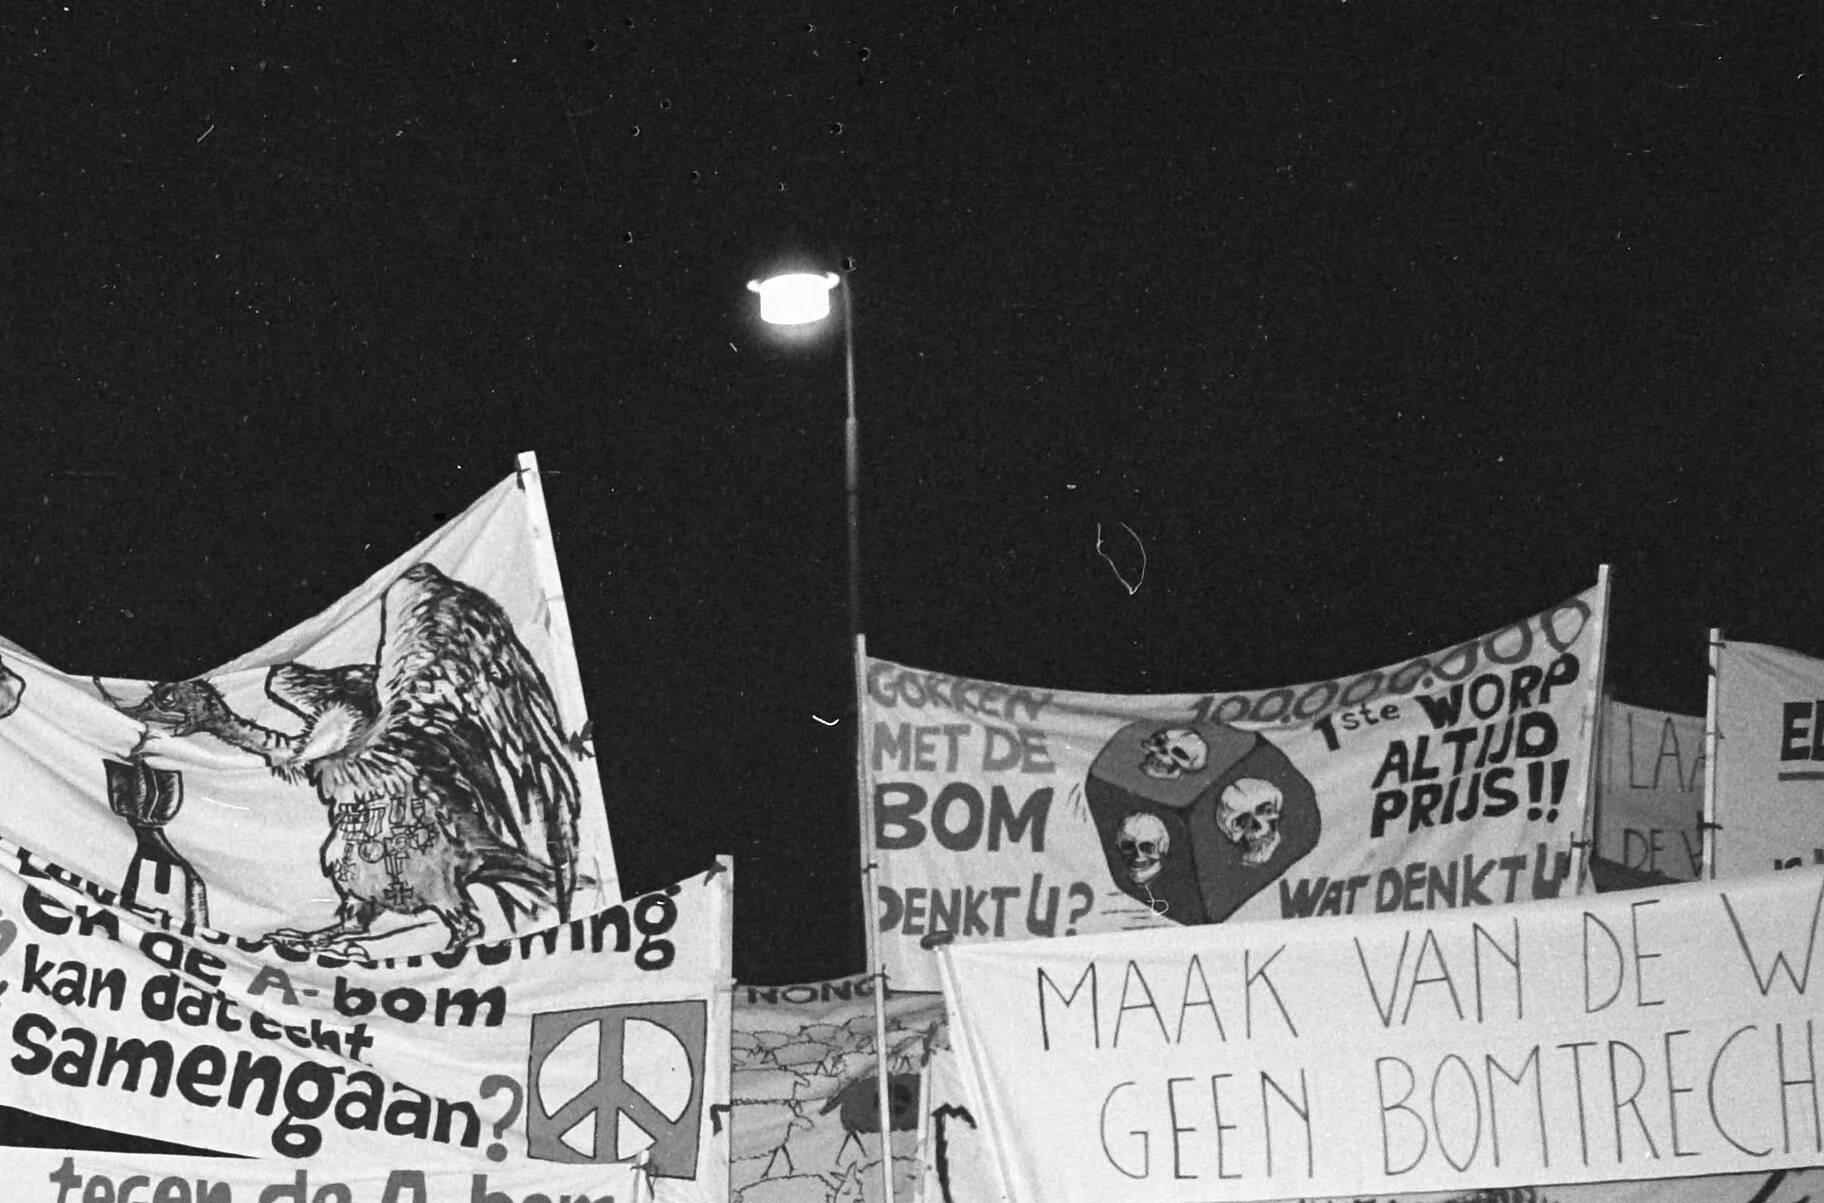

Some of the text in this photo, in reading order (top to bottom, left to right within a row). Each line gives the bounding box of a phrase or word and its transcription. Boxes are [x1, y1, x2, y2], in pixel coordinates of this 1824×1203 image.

[868, 664, 1054, 721] GOKKEN
[1313, 653, 1580, 751] 1ste WORP
[875, 721, 1056, 773] MET DE
[1371, 711, 1558, 787] ALTIJD
[876, 781, 1054, 852] BOM
[1370, 758, 1570, 838] PRIJS!!
[877, 873, 1095, 938] DENKT U?
[1279, 874, 1373, 920] WAT
[1375, 853, 1527, 914] DENKT
[21, 943, 127, 1012] kan
[140, 971, 243, 1034] dat
[246, 963, 507, 1028] A-bom
[1036, 944, 1299, 1052] MAAK
[1354, 916, 1524, 1029] VAN
[1582, 899, 1666, 1014] DE
[11, 1013, 525, 1163] samengaan?
[1100, 1019, 1824, 1181] GEEN BOMTRECH
